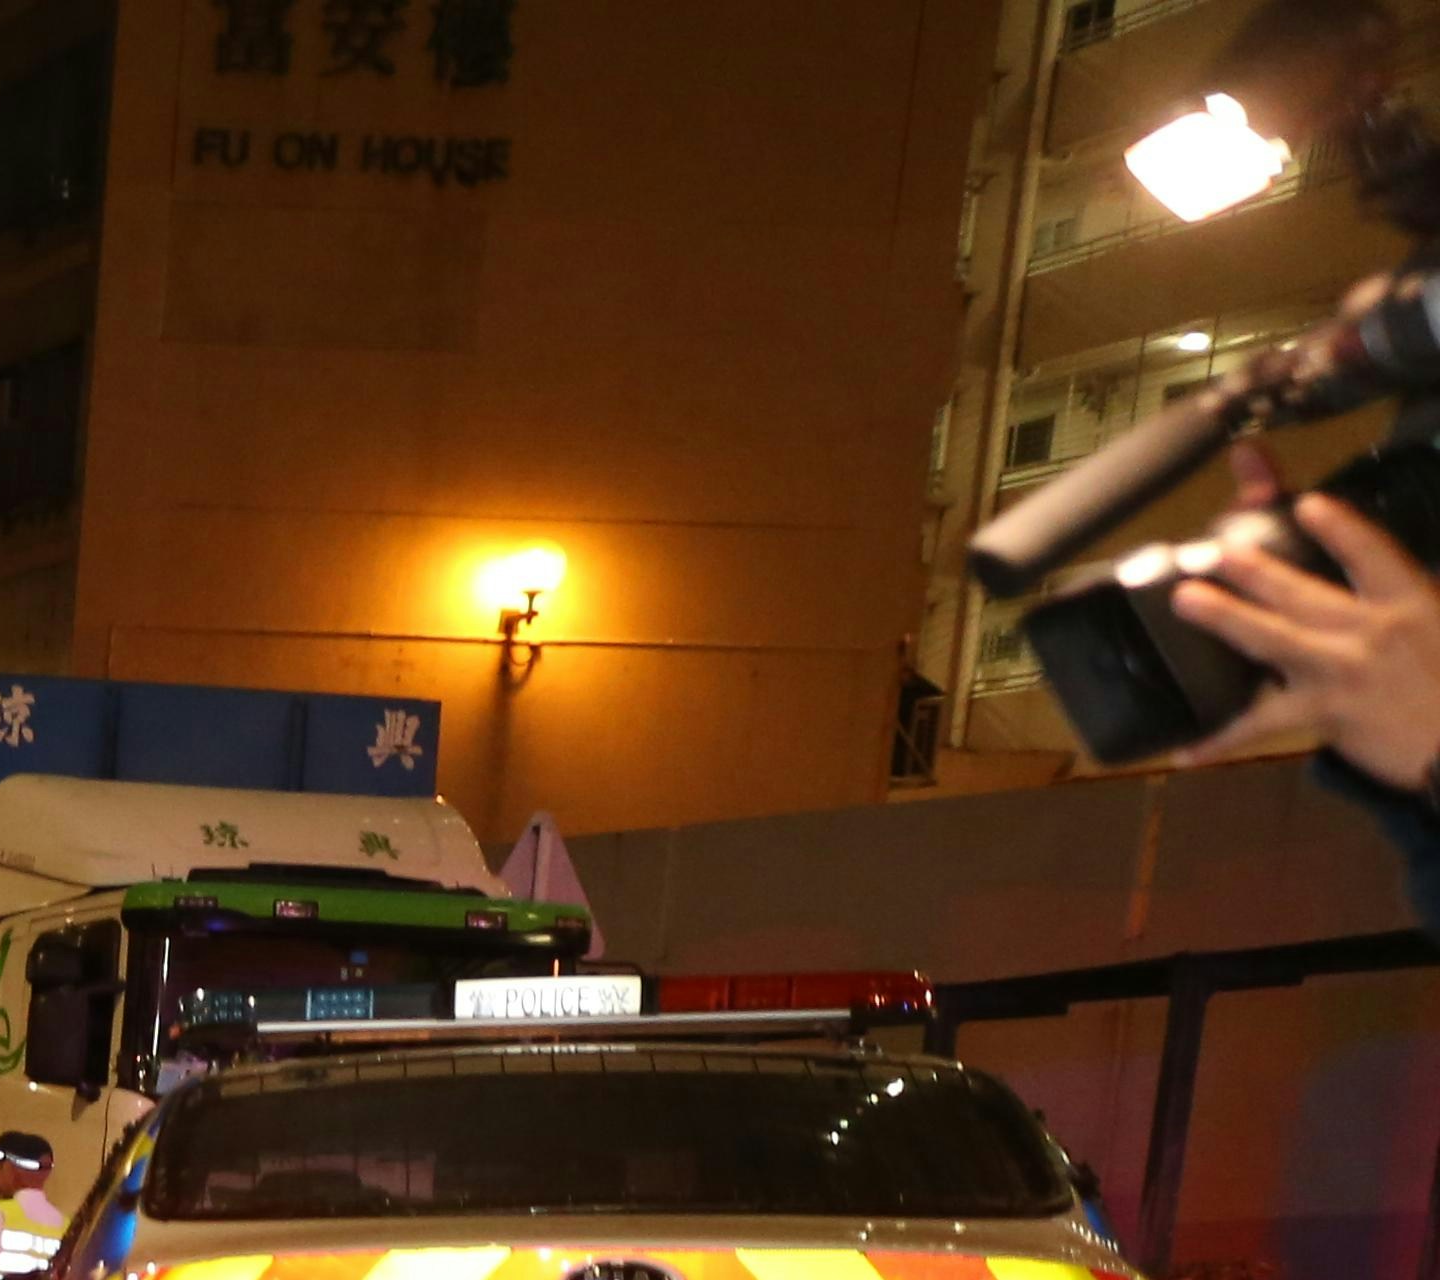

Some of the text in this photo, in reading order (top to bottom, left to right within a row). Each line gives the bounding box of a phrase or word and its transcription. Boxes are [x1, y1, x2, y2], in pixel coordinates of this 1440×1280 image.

[193, 127, 513, 187] FU ON HOUSE
[505, 986, 592, 1019] POLICE
